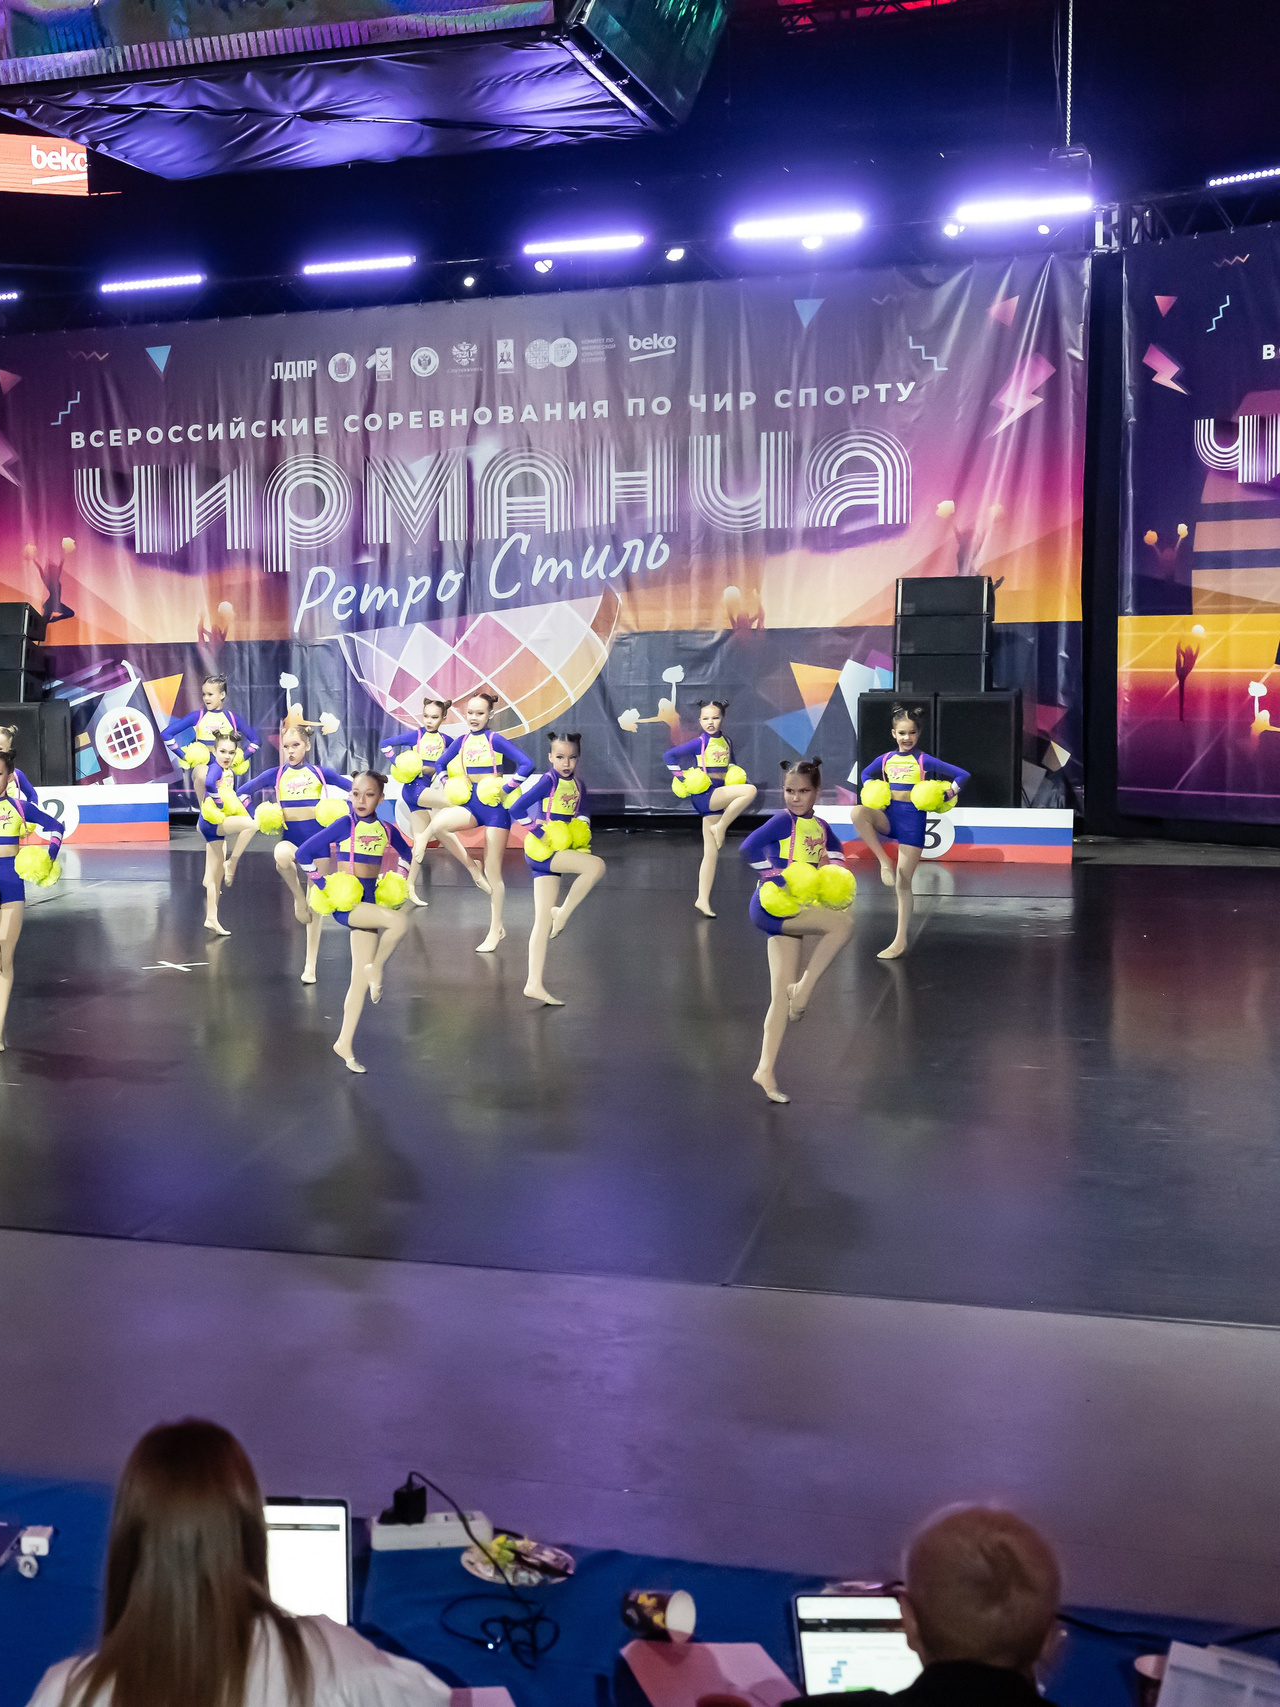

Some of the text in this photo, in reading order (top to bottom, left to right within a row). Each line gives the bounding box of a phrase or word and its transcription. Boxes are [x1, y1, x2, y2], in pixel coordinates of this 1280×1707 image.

[628, 333, 677, 350] beko
[1262, 344, 1280, 360] В
[271, 360, 317, 381] ЛДПР
[70, 381, 916, 448] ВСЕРОССИЙСКИЕ СОРЕВНОВАНИЯ ПО ЧИР СПОРТУ
[293, 531, 672, 635] Ретро Стиль
[923, 818, 942, 849] 3
